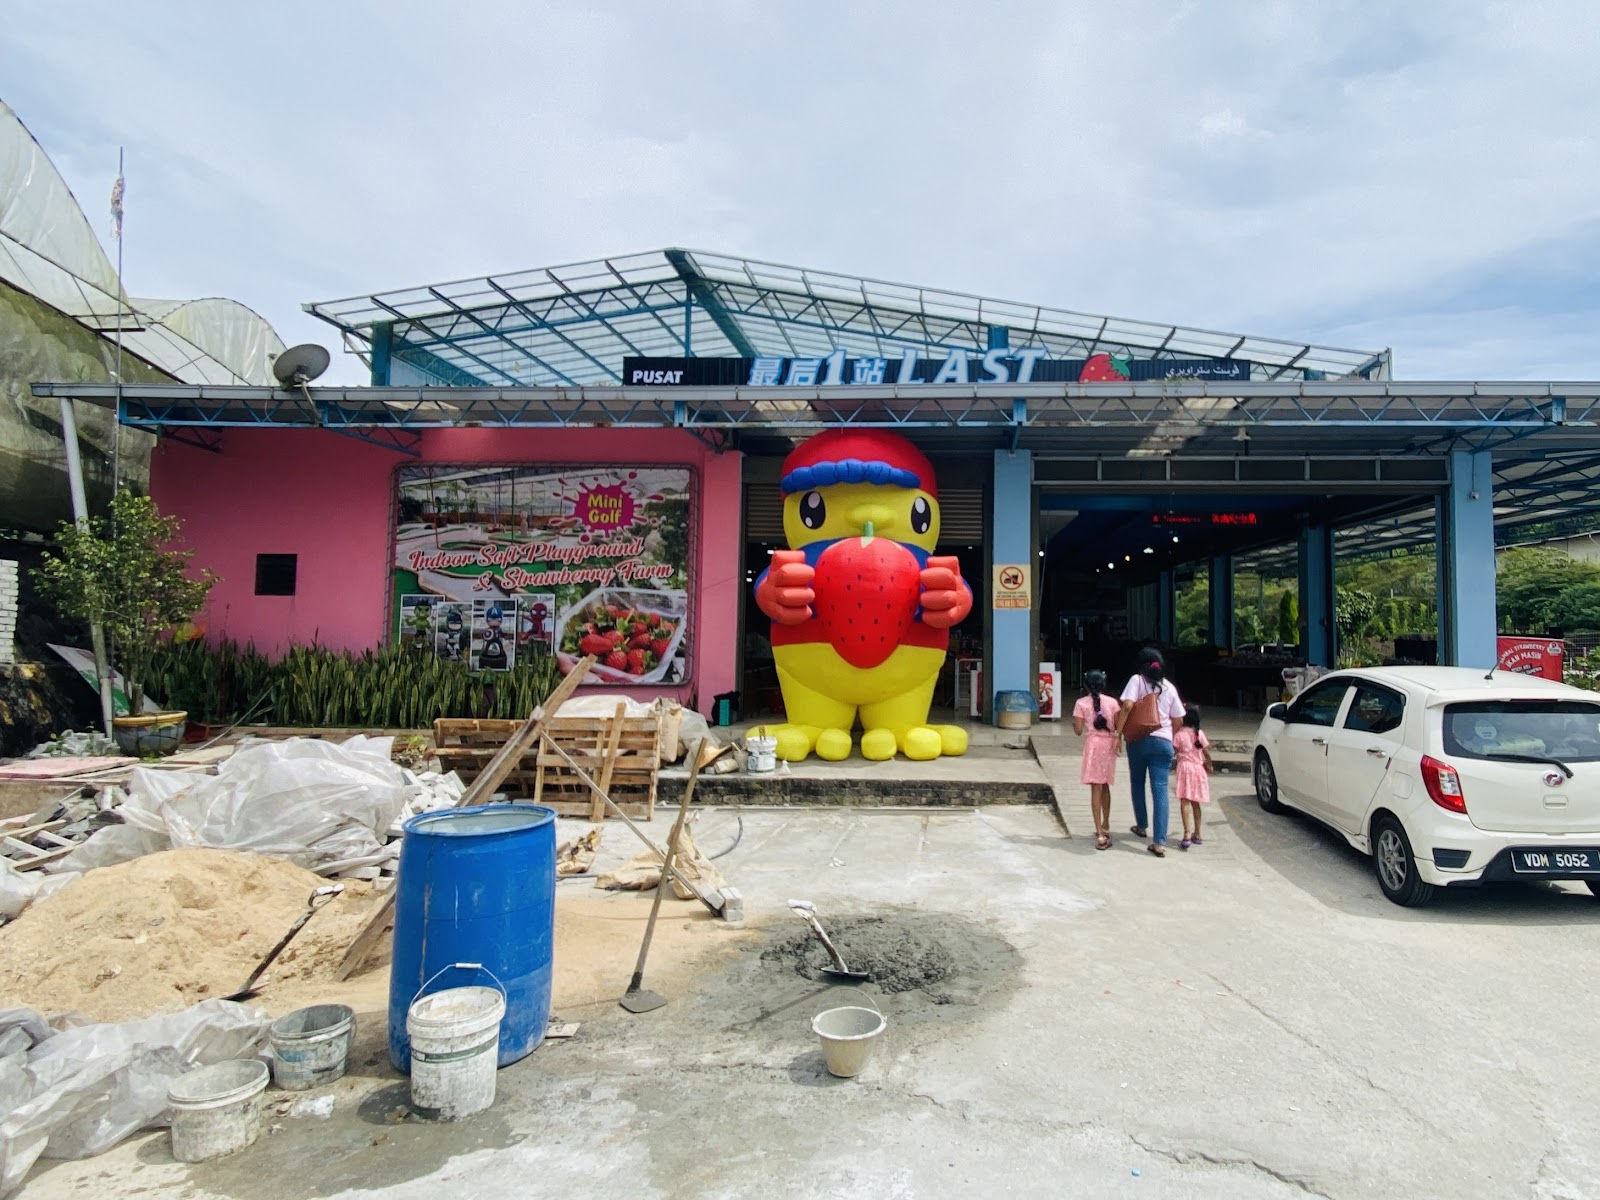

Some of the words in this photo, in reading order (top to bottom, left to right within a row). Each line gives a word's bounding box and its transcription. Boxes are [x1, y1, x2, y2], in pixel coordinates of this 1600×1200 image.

[897, 348, 1046, 384] LAST
[632, 370, 683, 384] PUSAT
[586, 494, 623, 508] Mini
[588, 508, 623, 525] Golf
[408, 549, 475, 571] Indoor
[477, 544, 519, 569] Soft
[519, 538, 643, 564] Playground
[471, 572, 492, 592] &
[500, 566, 614, 590] Strawberry
[615, 559, 674, 579] Farm
[1505, 654, 1520, 668] IKAN
[1520, 651, 1542, 660] MASIN
[1524, 853, 1550, 867] VDM
[1556, 853, 1590, 867] 5052
